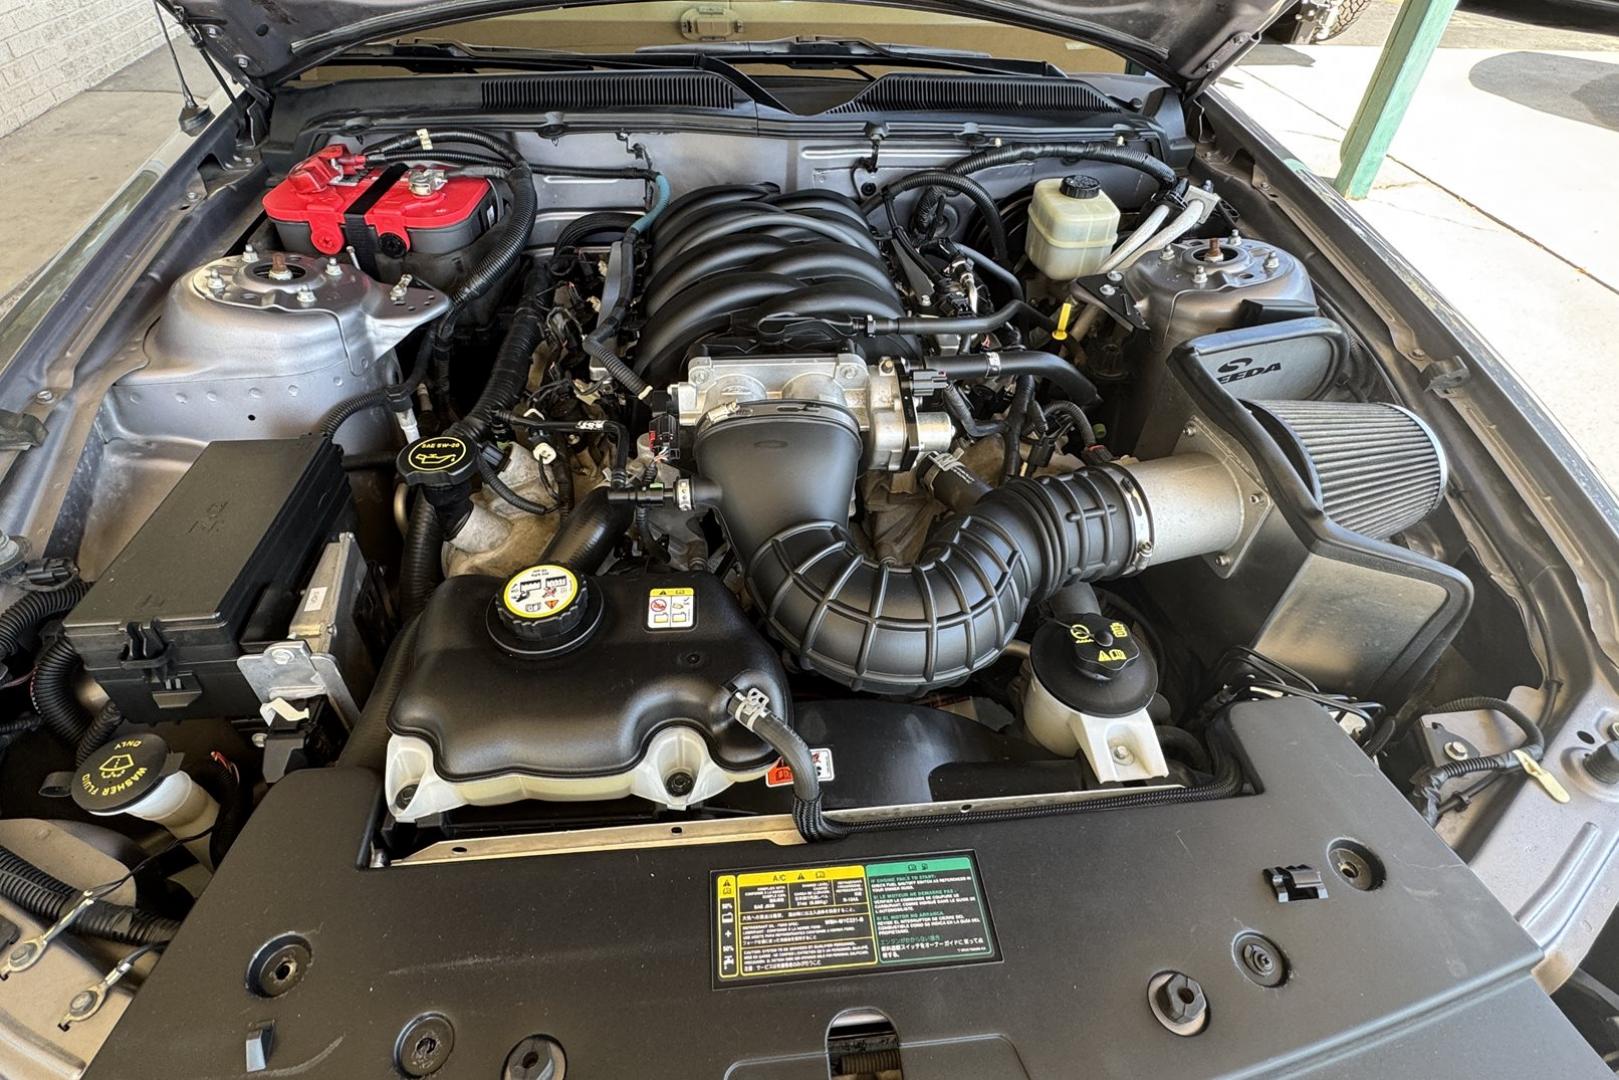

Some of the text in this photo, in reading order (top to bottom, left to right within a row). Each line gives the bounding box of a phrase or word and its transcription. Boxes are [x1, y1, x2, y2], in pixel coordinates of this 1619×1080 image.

[114, 740, 142, 750] ONLY
[82, 767, 148, 796] WASHER FLUID
